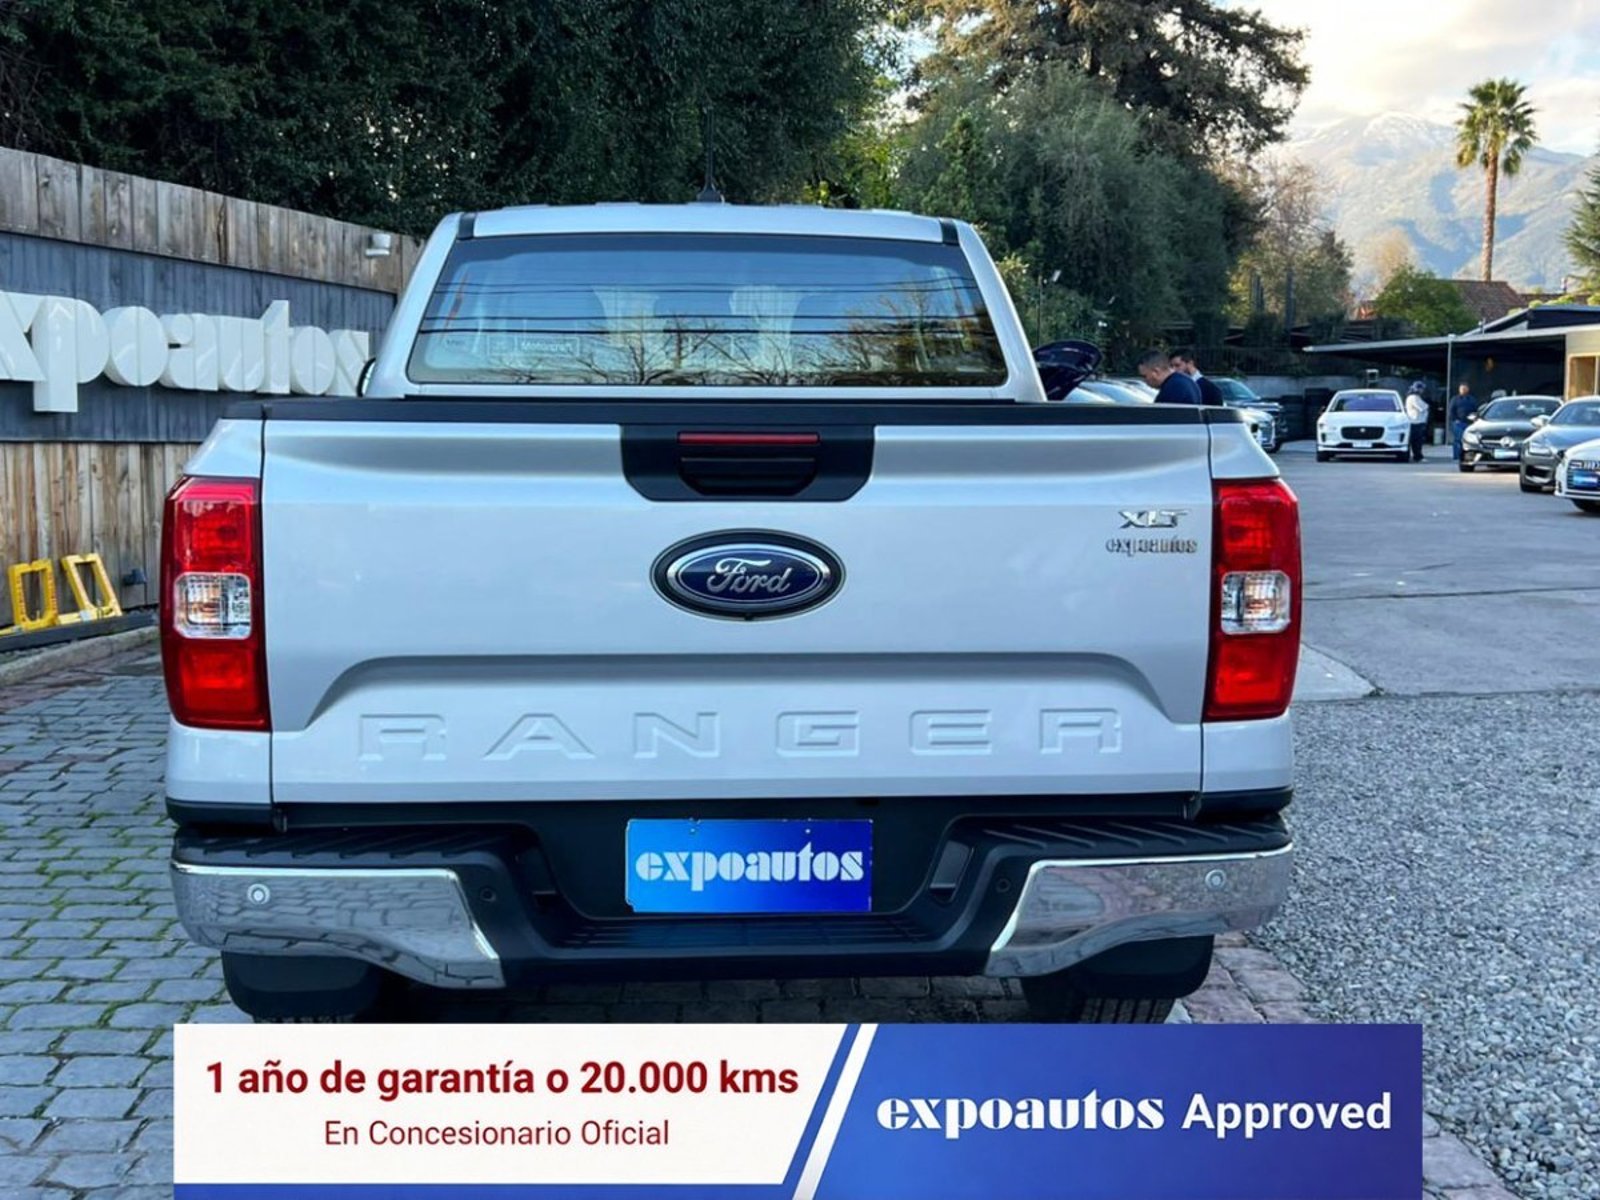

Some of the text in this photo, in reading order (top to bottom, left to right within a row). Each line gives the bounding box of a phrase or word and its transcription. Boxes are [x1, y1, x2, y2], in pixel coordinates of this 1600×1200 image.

[1118, 508, 1190, 529] XLT
[706, 557, 793, 593] Ford
[358, 707, 1122, 762] RANGER
[635, 841, 864, 891] expoautos
